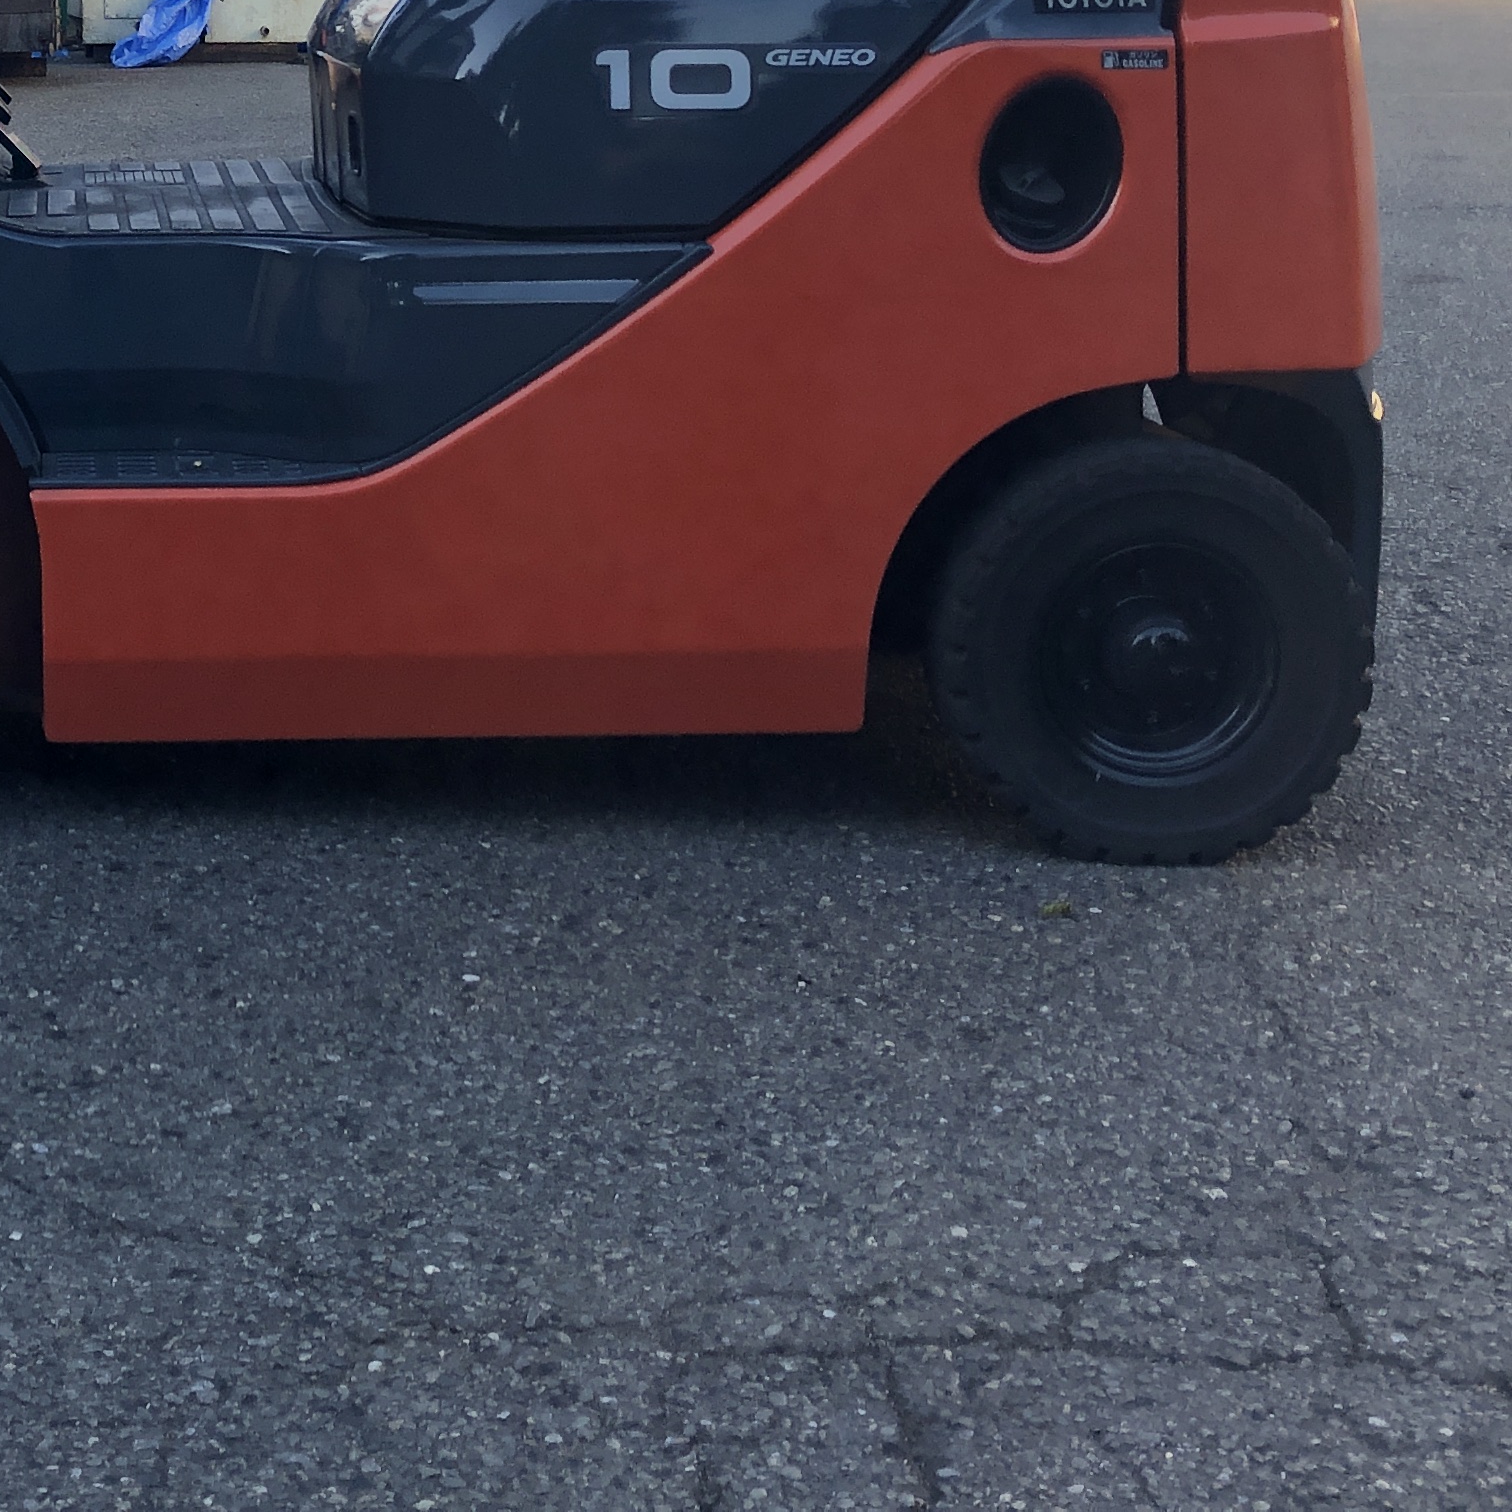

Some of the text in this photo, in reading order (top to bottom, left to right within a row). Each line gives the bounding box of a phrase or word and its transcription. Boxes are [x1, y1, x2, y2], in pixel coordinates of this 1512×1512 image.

[595, 48, 876, 110] 10 GENEO
[1122, 58, 1164, 69] GASOLINE
